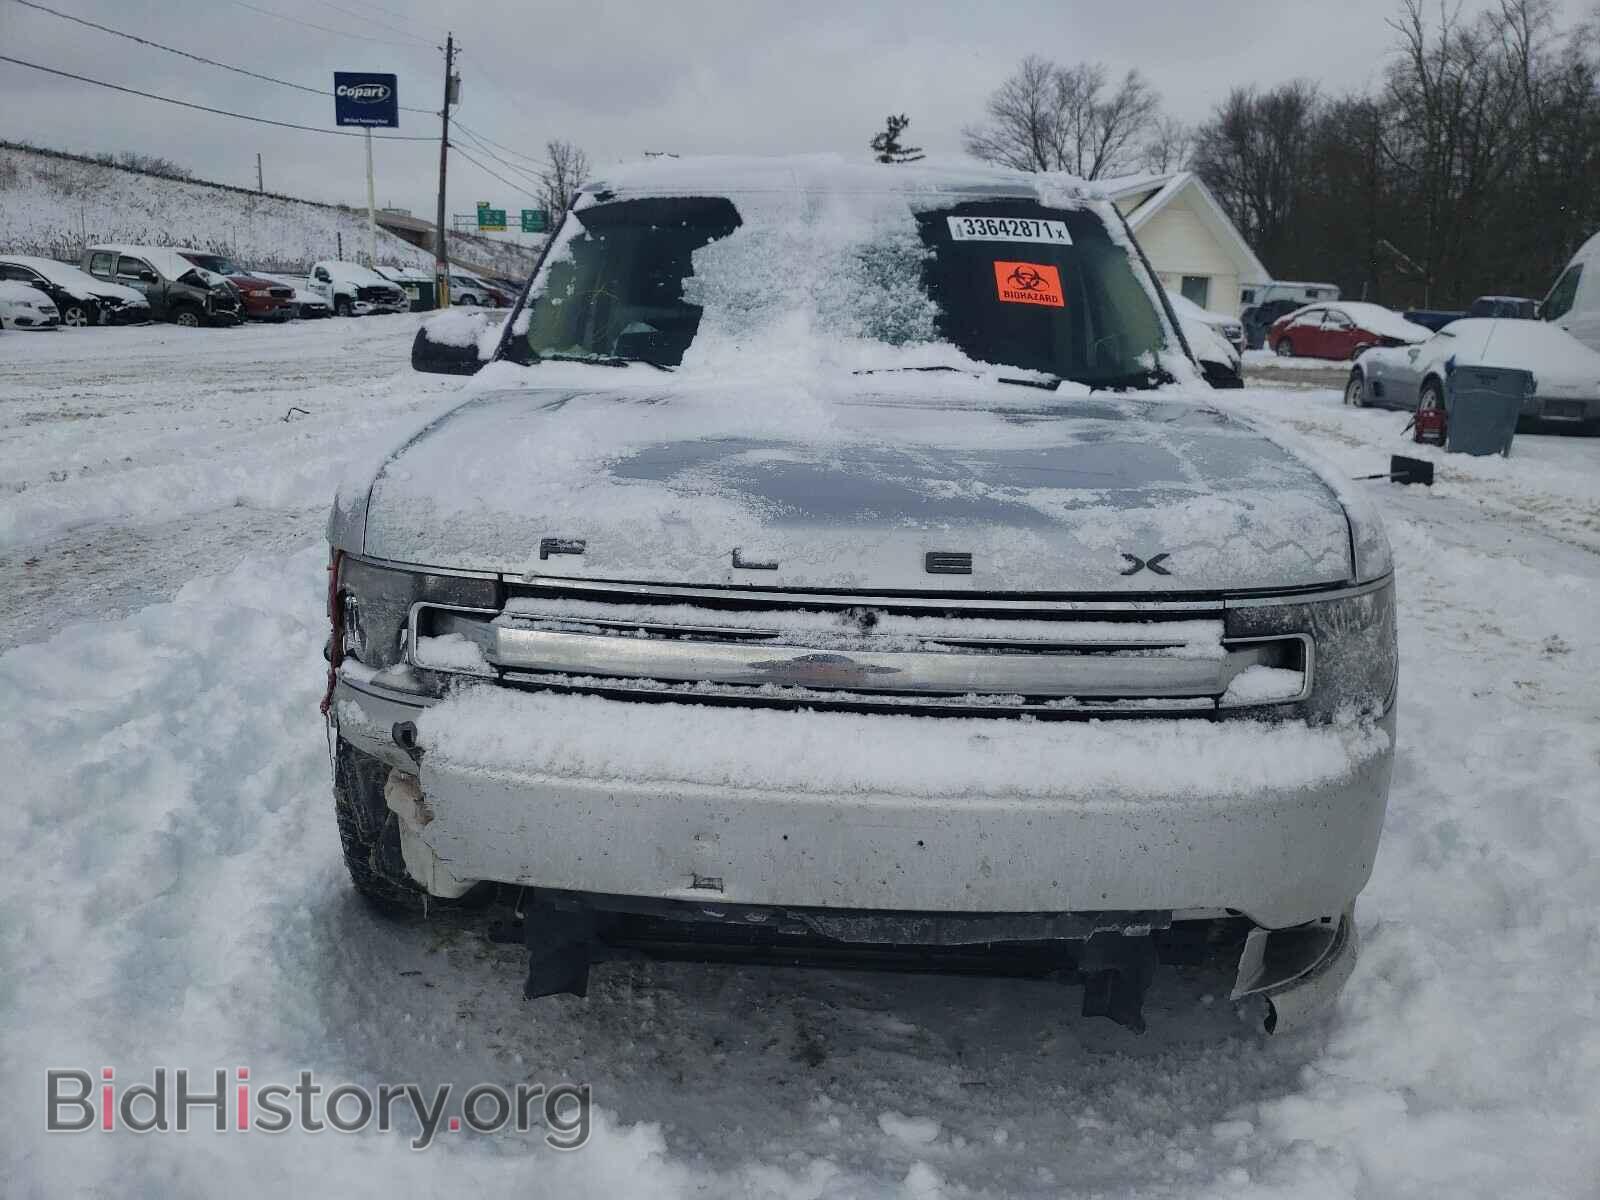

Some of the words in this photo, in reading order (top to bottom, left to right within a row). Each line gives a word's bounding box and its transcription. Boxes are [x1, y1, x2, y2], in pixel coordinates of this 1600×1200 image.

[336, 84, 385, 100] Copart
[963, 218, 1053, 239] 33642871
[1003, 289, 1059, 304] BIOHAZARD
